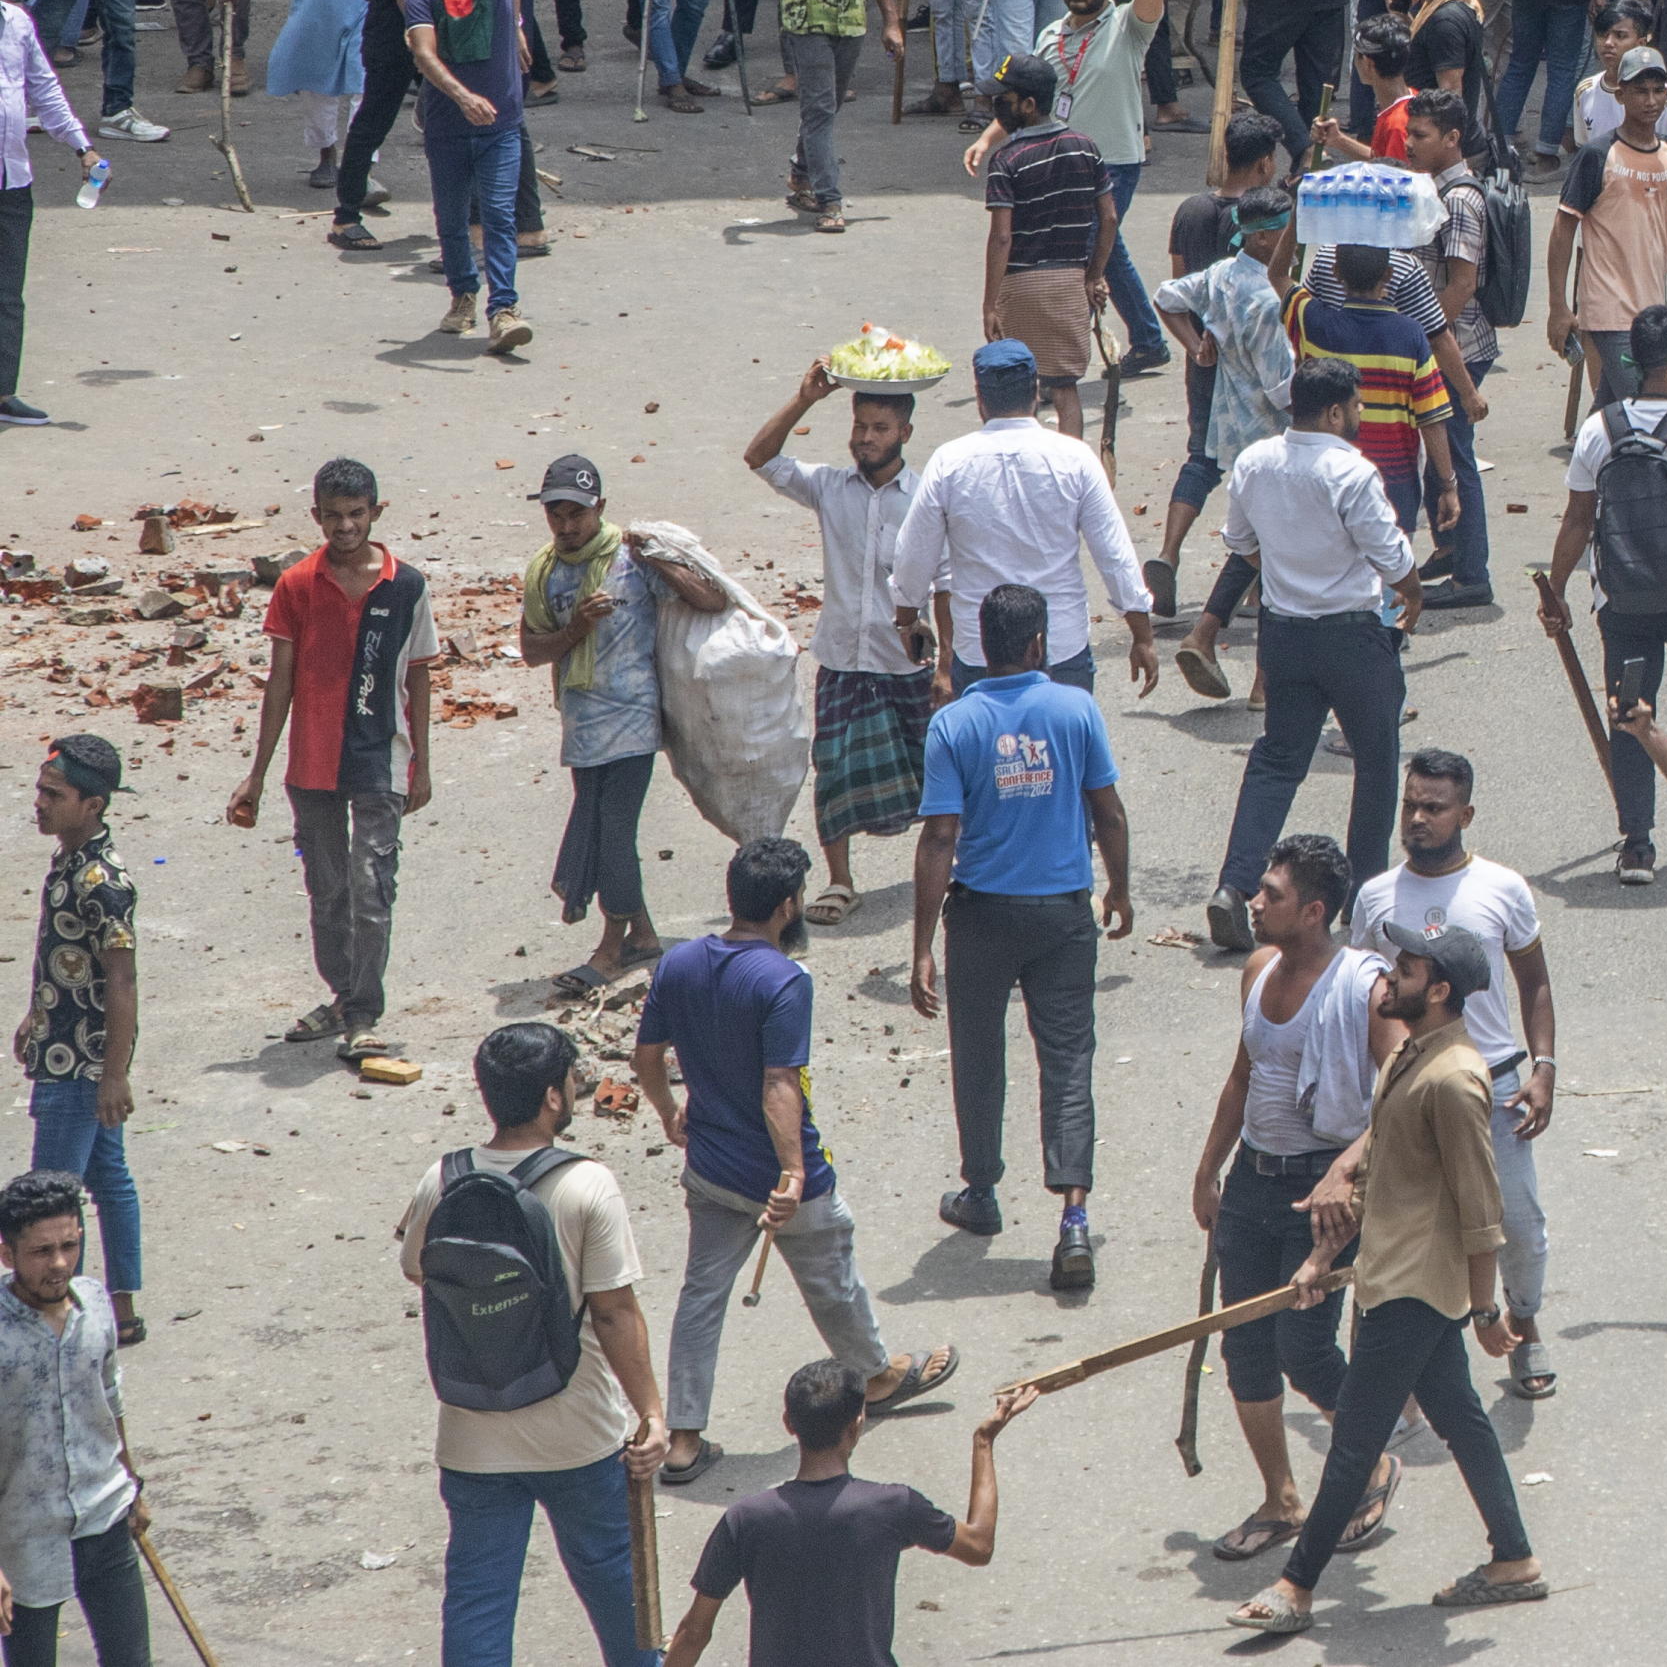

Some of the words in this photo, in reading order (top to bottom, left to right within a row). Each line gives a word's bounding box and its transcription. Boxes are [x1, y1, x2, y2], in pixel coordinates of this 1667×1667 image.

[995, 762, 1024, 777] SALES
[996, 770, 1052, 788] CONFERENCE
[1030, 783, 1053, 797] 2022
[494, 1271, 520, 1283] acer
[472, 1293, 529, 1317] Extensa
